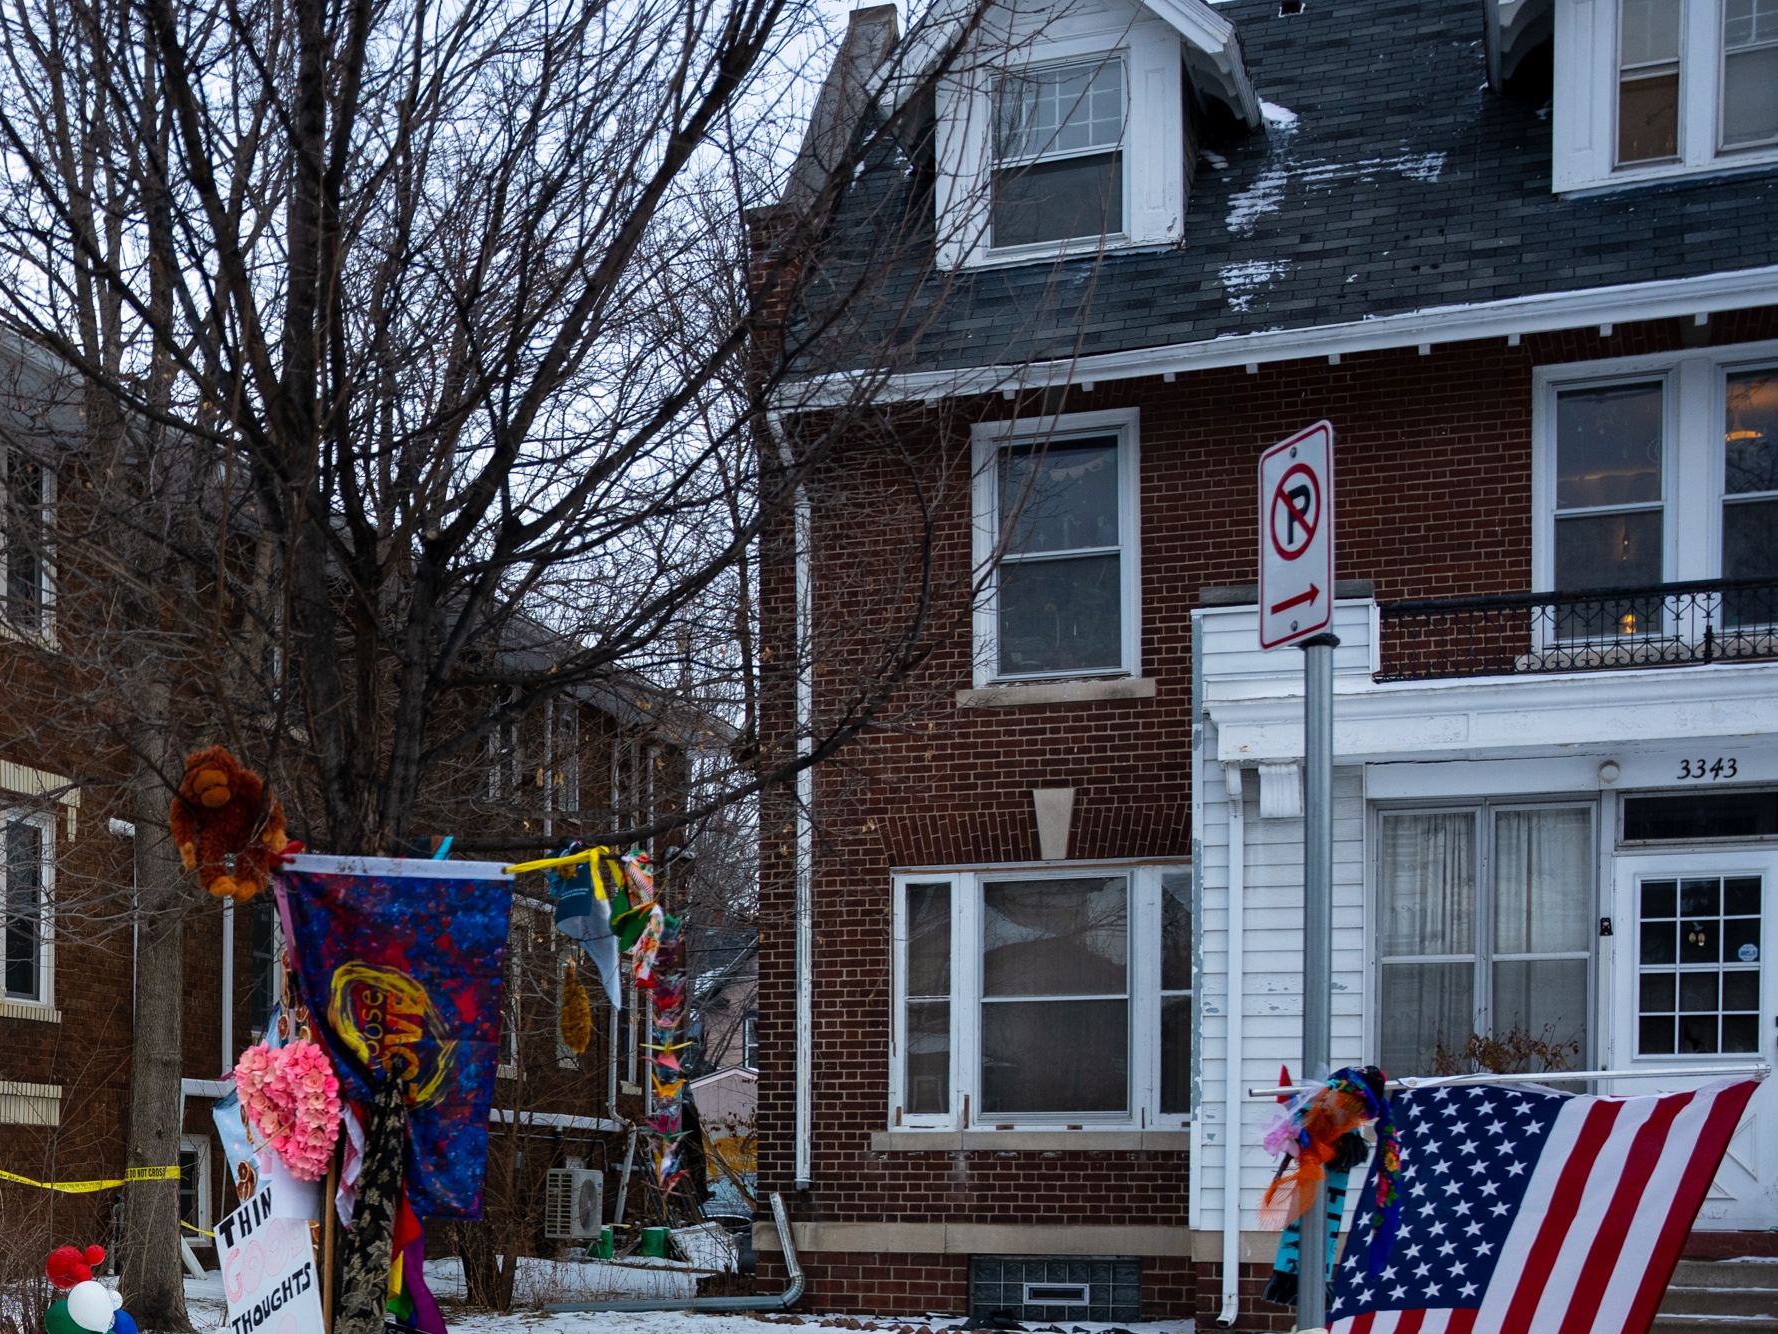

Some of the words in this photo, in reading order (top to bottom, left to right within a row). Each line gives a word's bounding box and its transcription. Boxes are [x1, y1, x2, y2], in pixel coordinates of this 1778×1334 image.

[1677, 758, 1738, 781] 3343
[129, 1169, 136, 1179] DO
[137, 1168, 148, 1178] NOT
[219, 1186, 272, 1249] THIN
[224, 1218, 306, 1304] GOOD
